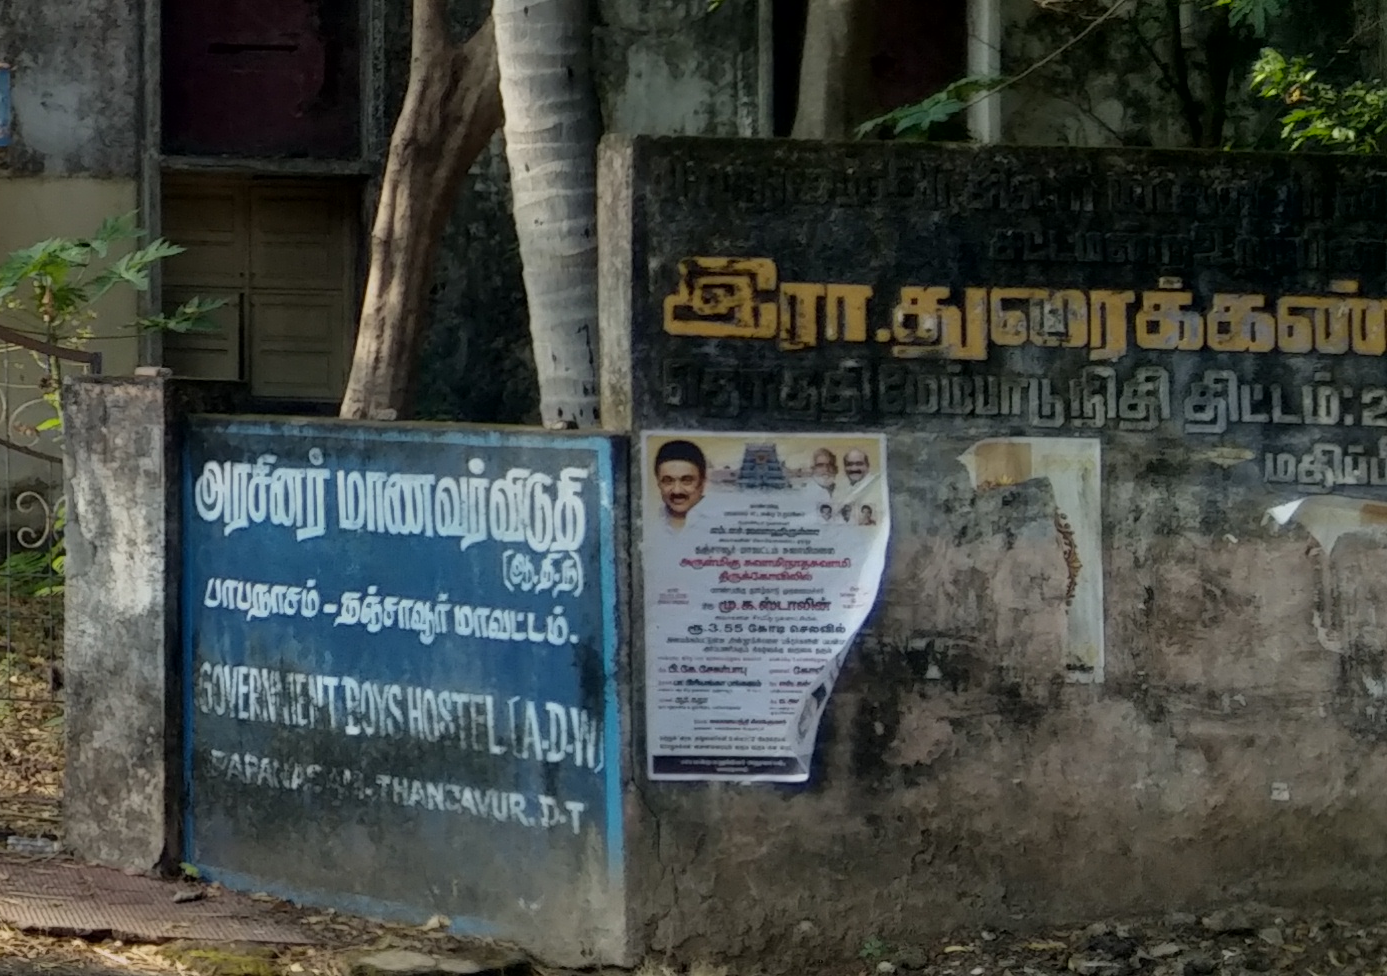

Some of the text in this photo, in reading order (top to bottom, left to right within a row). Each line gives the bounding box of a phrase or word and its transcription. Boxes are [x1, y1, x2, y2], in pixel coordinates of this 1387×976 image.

[195, 448, 331, 542] அரசினர்
[204, 577, 320, 622] பாபநாசம்
[334, 585, 453, 645] தஞ்சாவூர்
[687, 623, 744, 635] ரூ.3.55
[789, 622, 847, 634] செலவில்
[341, 675, 405, 738] BOYS
[406, 686, 507, 755] HOSTEL
